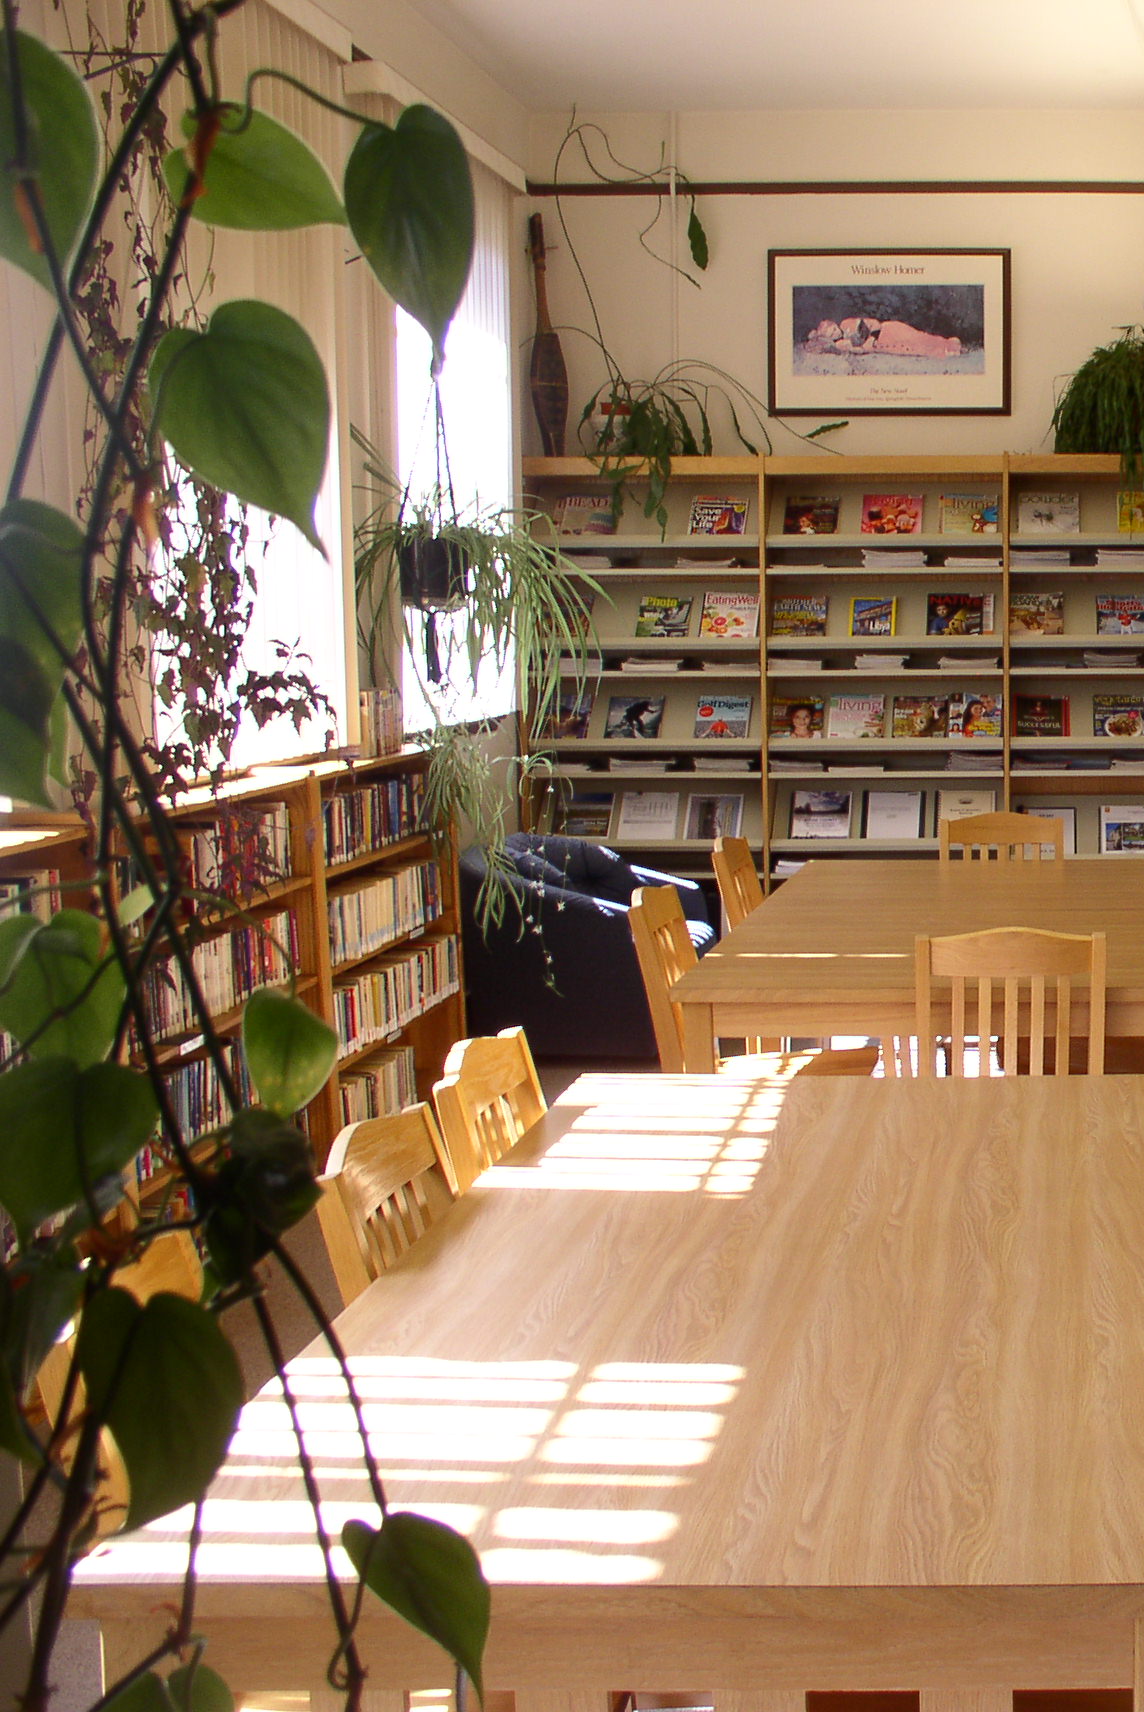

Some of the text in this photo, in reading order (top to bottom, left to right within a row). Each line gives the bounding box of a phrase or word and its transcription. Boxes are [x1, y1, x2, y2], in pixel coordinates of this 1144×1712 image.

[850, 264, 925, 275] Winslow Homer
[646, 597, 678, 608] Photo
[697, 700, 749, 710] Golf Digest
[838, 699, 883, 713] living
